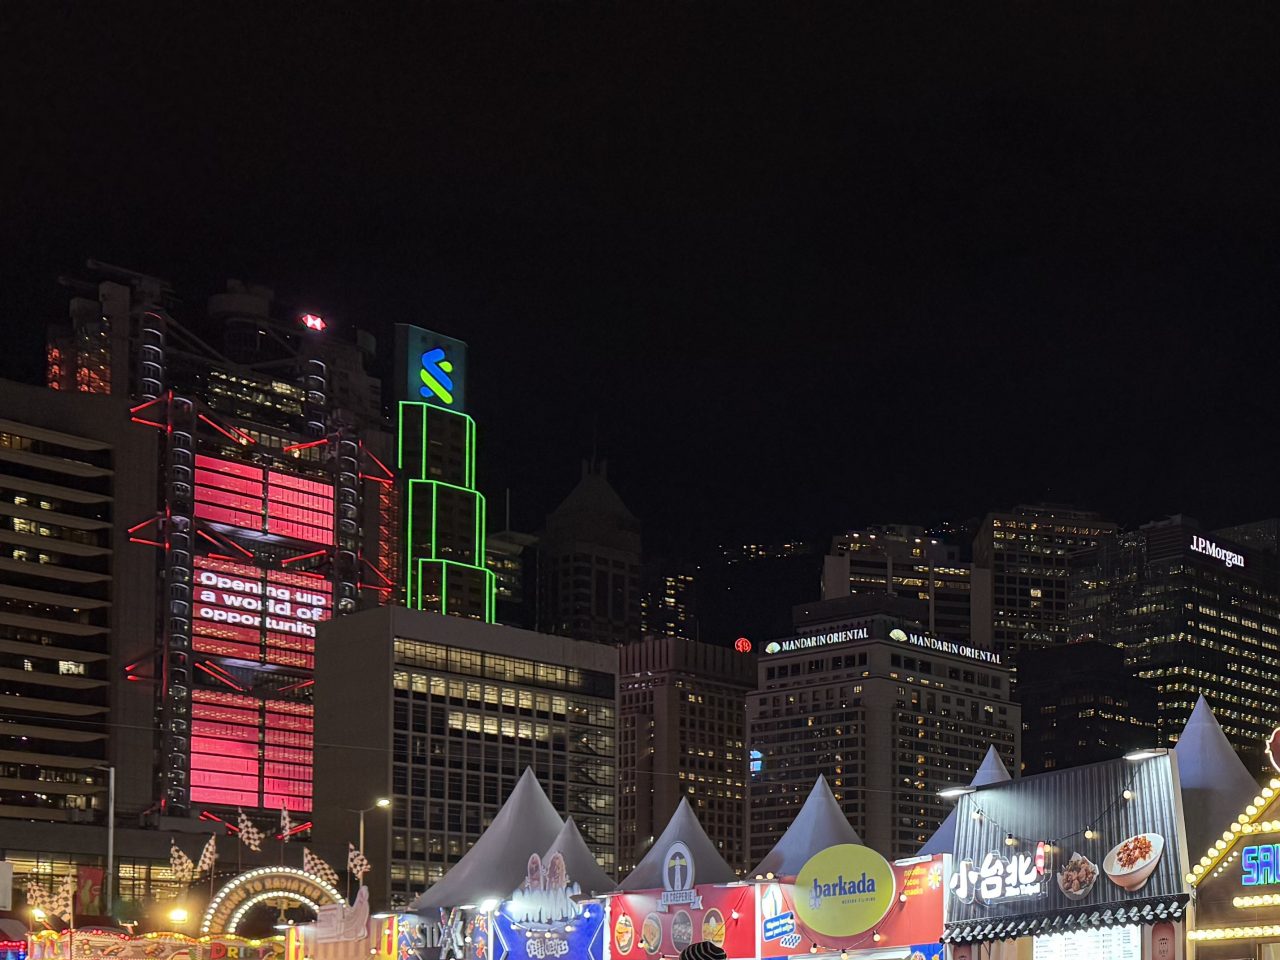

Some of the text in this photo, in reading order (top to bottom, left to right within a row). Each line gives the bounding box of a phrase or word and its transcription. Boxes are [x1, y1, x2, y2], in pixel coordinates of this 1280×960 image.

[1190, 535, 1244, 567] J.P.Morgan
[200, 572, 326, 606] Opening up
[200, 590, 323, 620] a world of
[781, 628, 869, 651] MANDARIN ORIENTAL
[909, 634, 1002, 664] MANDARIN ORIENTAL
[813, 872, 876, 898] barkada
[950, 852, 1038, 899] 小台北
